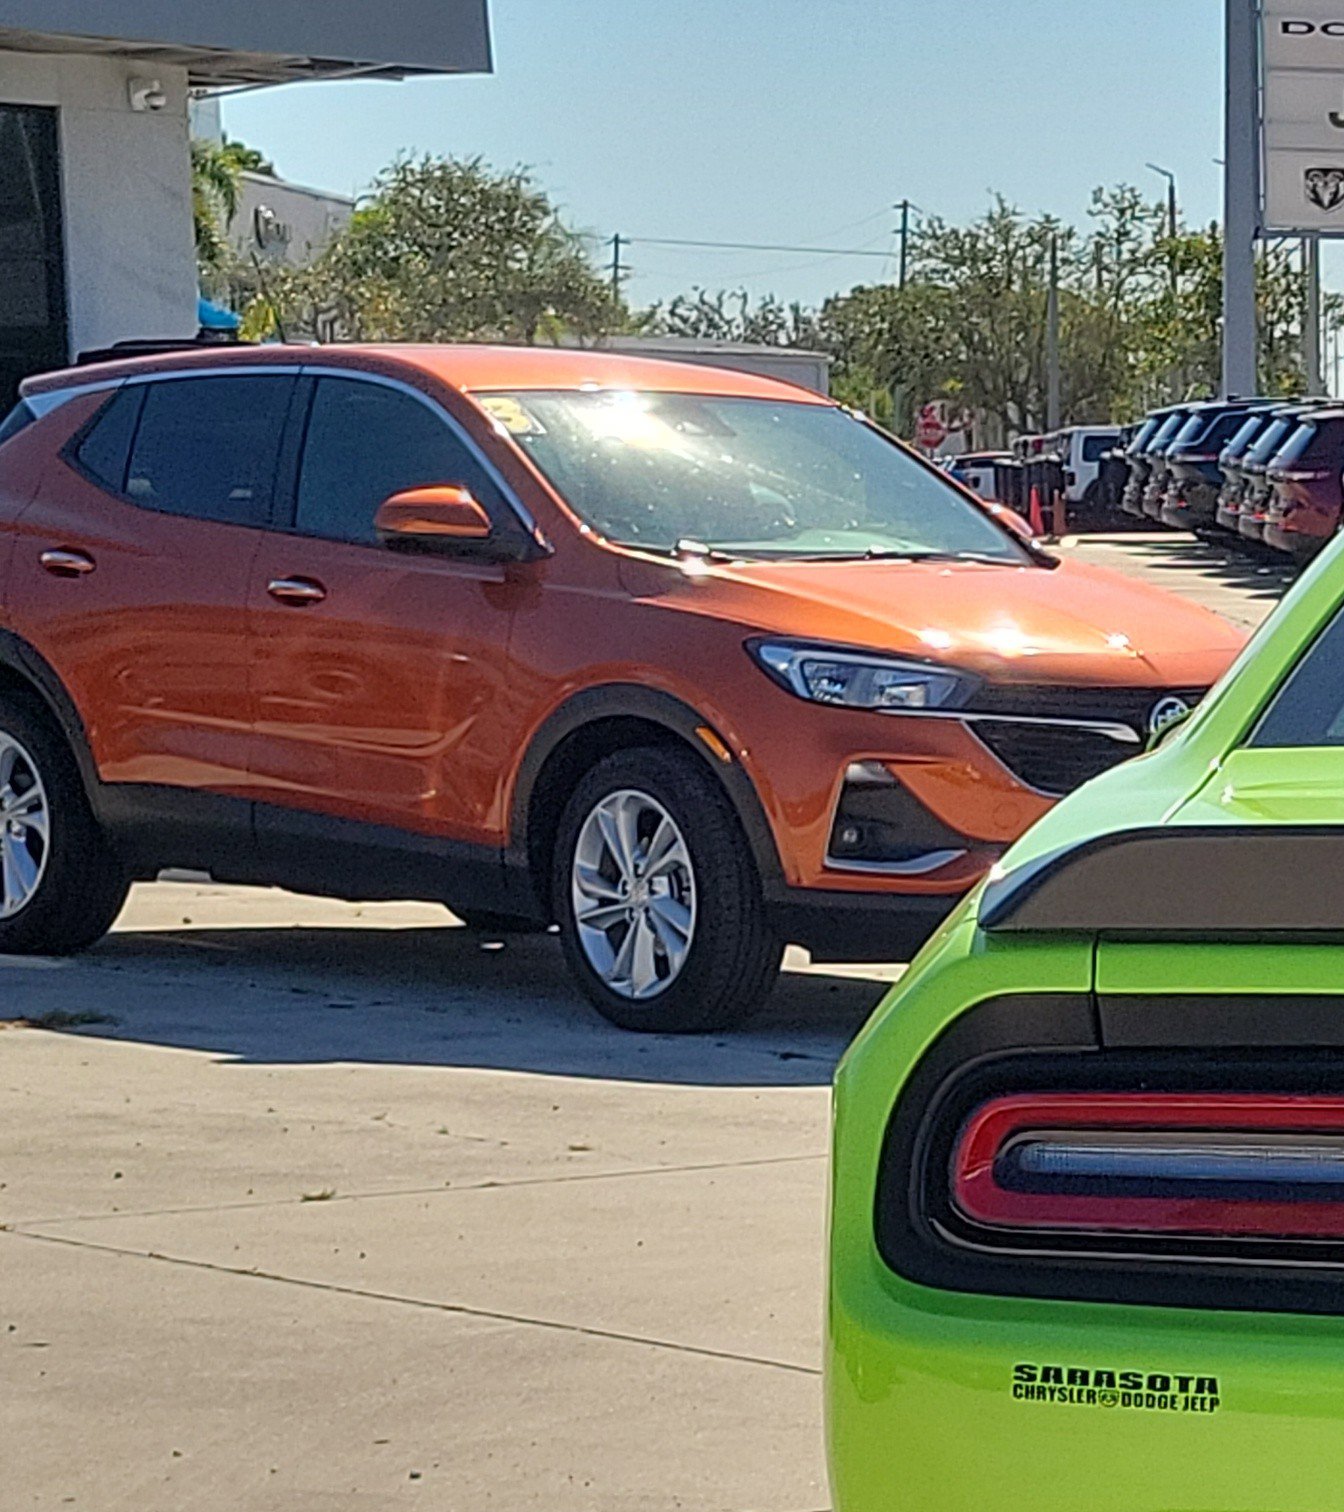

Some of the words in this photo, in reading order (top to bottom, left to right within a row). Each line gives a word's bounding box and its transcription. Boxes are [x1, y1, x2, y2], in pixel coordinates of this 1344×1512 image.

[1013, 1363, 1219, 1395] SARASOTA
[1012, 1384, 1097, 1405] CHRYSLER
[1121, 1392, 1178, 1411] DODGE
[1182, 1395, 1220, 1413] JEEP
